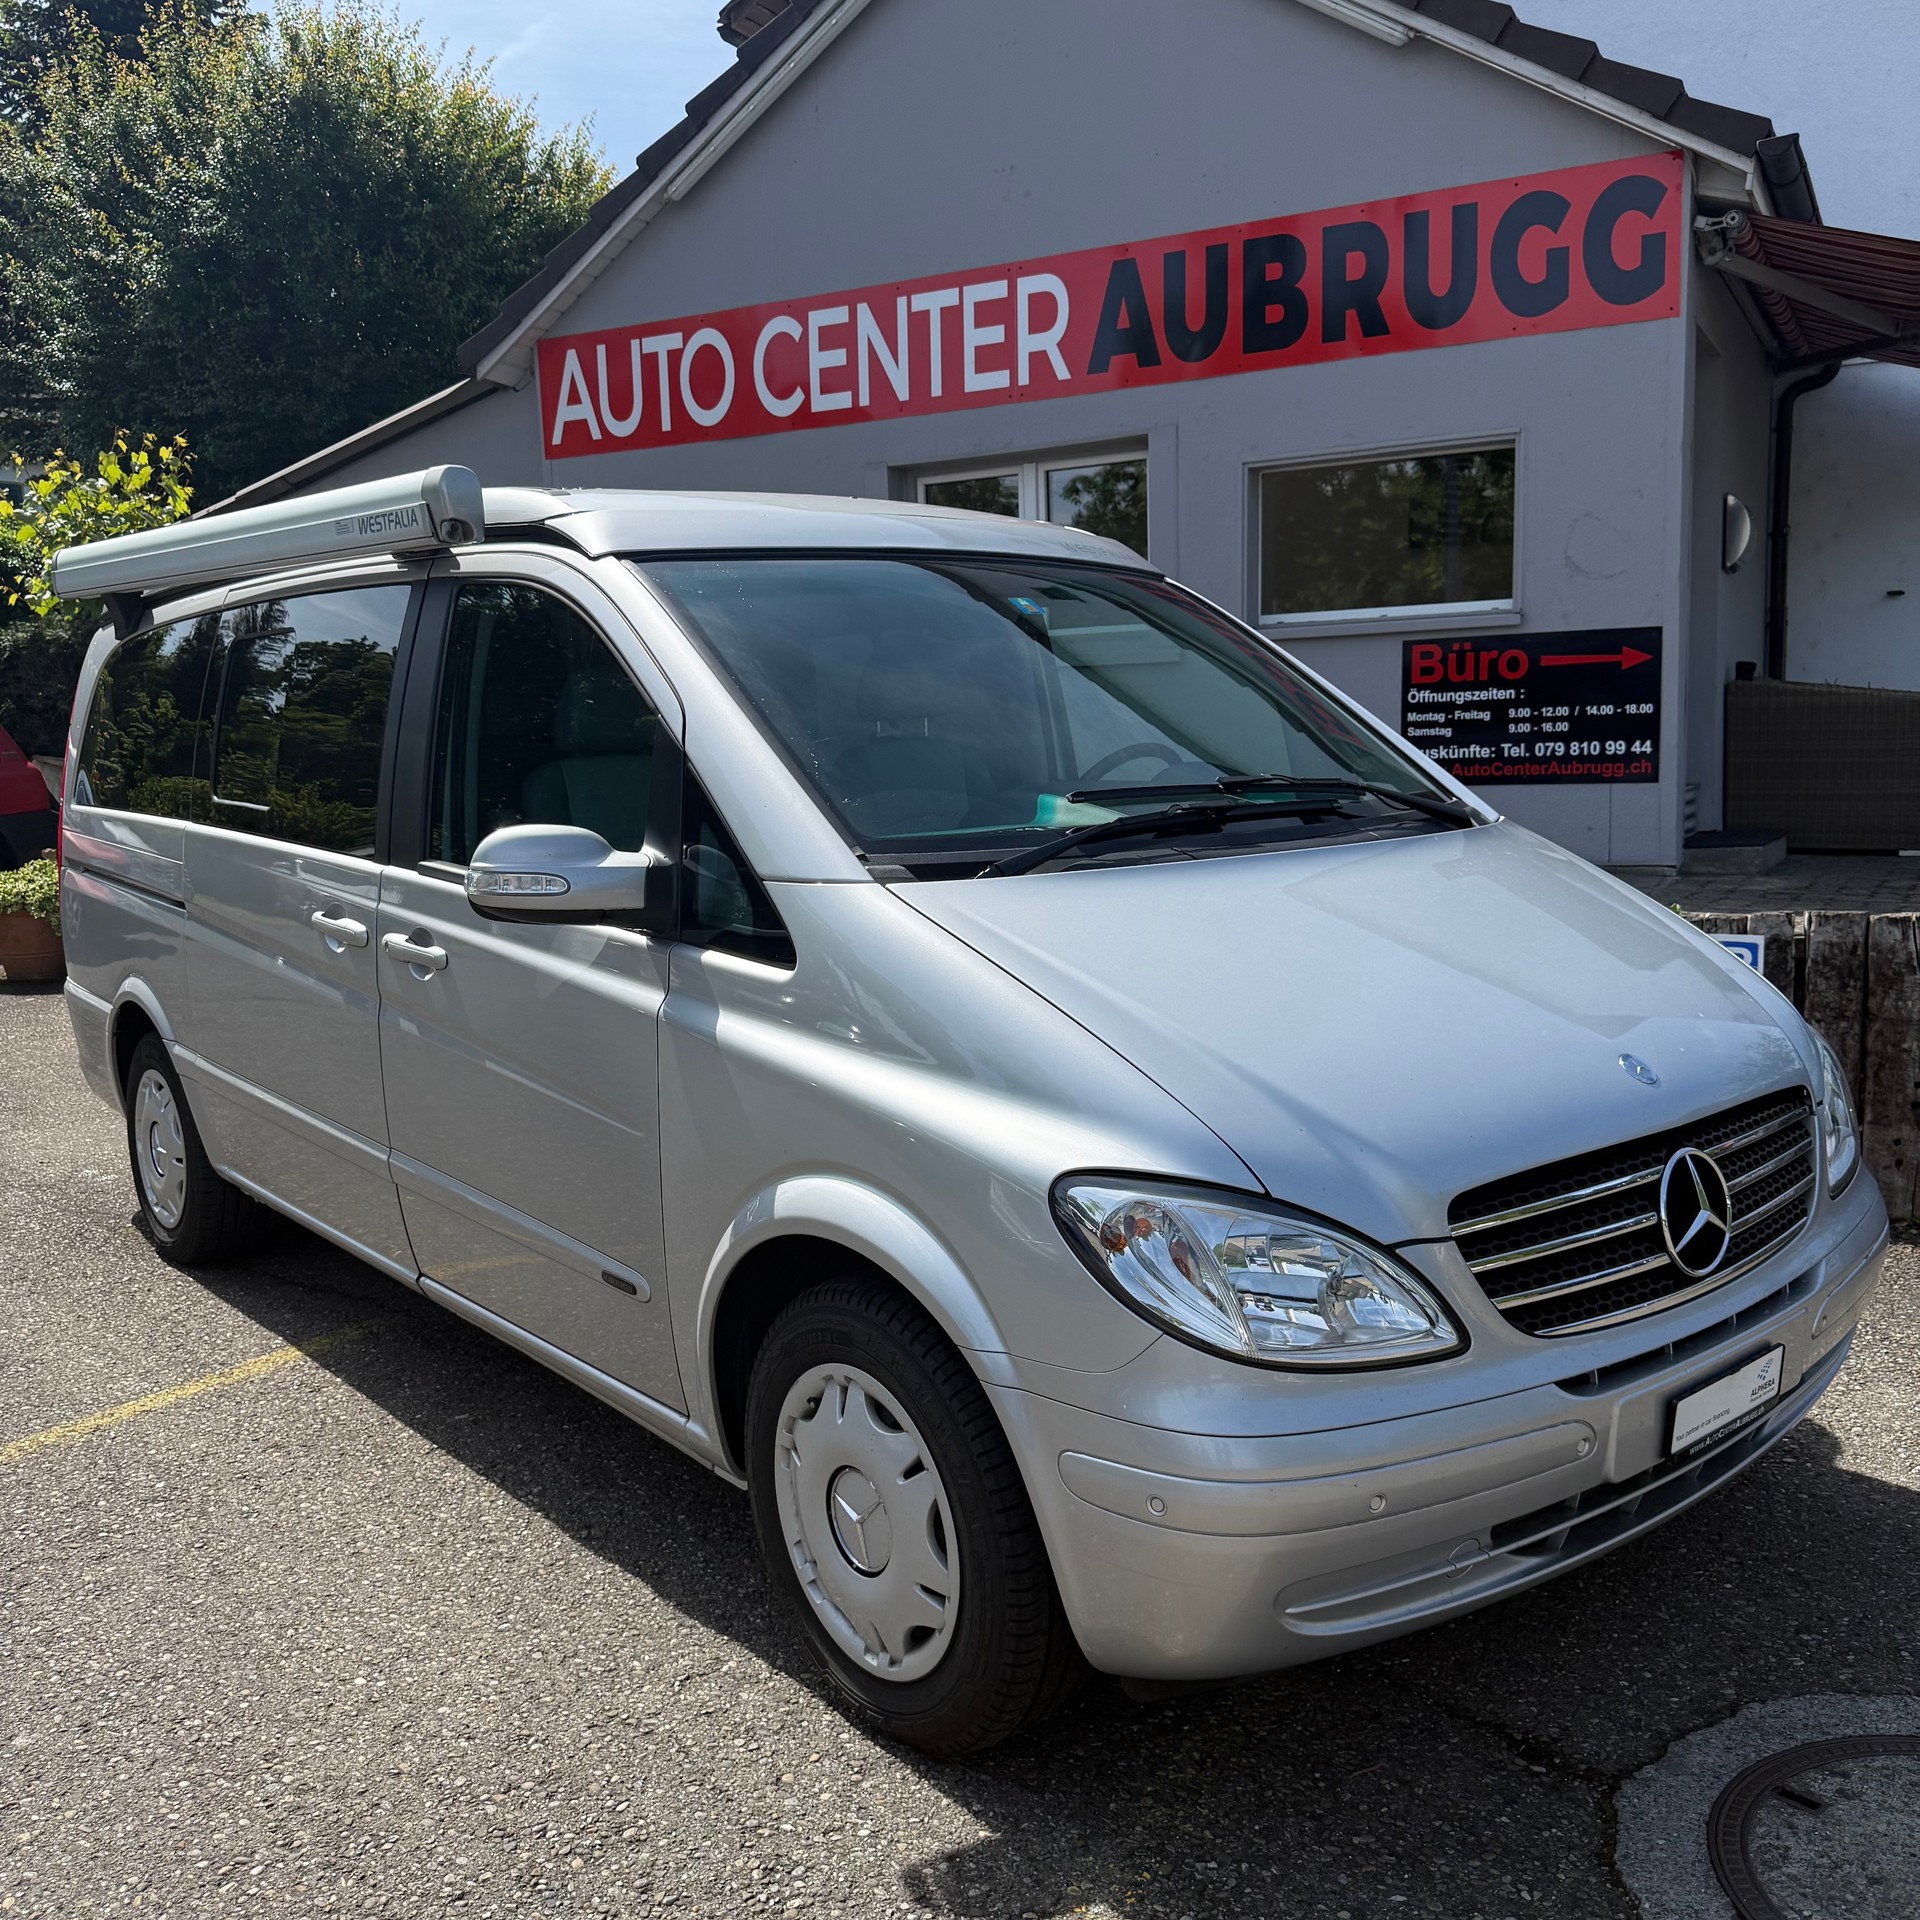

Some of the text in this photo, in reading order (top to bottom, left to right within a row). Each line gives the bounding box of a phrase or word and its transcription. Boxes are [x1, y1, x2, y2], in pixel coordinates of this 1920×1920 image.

[552, 175, 1669, 445] AUTO CENTER AUBRUGG
[357, 508, 419, 536] WESTFALIA
[1411, 642, 1529, 684] Büro
[1407, 688, 1516, 704] Öffnungszeiten
[1407, 712, 1446, 723] Montag
[1454, 709, 1491, 721] Freitag
[1508, 707, 1531, 718] 9.00
[1541, 706, 1570, 717] 12.00
[1585, 704, 1614, 716] 14.00
[1624, 703, 1653, 715] 18.00
[1407, 726, 1452, 738] Samstag
[1508, 722, 1531, 733] 9.00
[1541, 721, 1569, 733] 16.00
[1419, 739, 1653, 759] uskünfte: Tel. 079 810 99 44
[1750, 1378, 1775, 1398] ALPHERA
